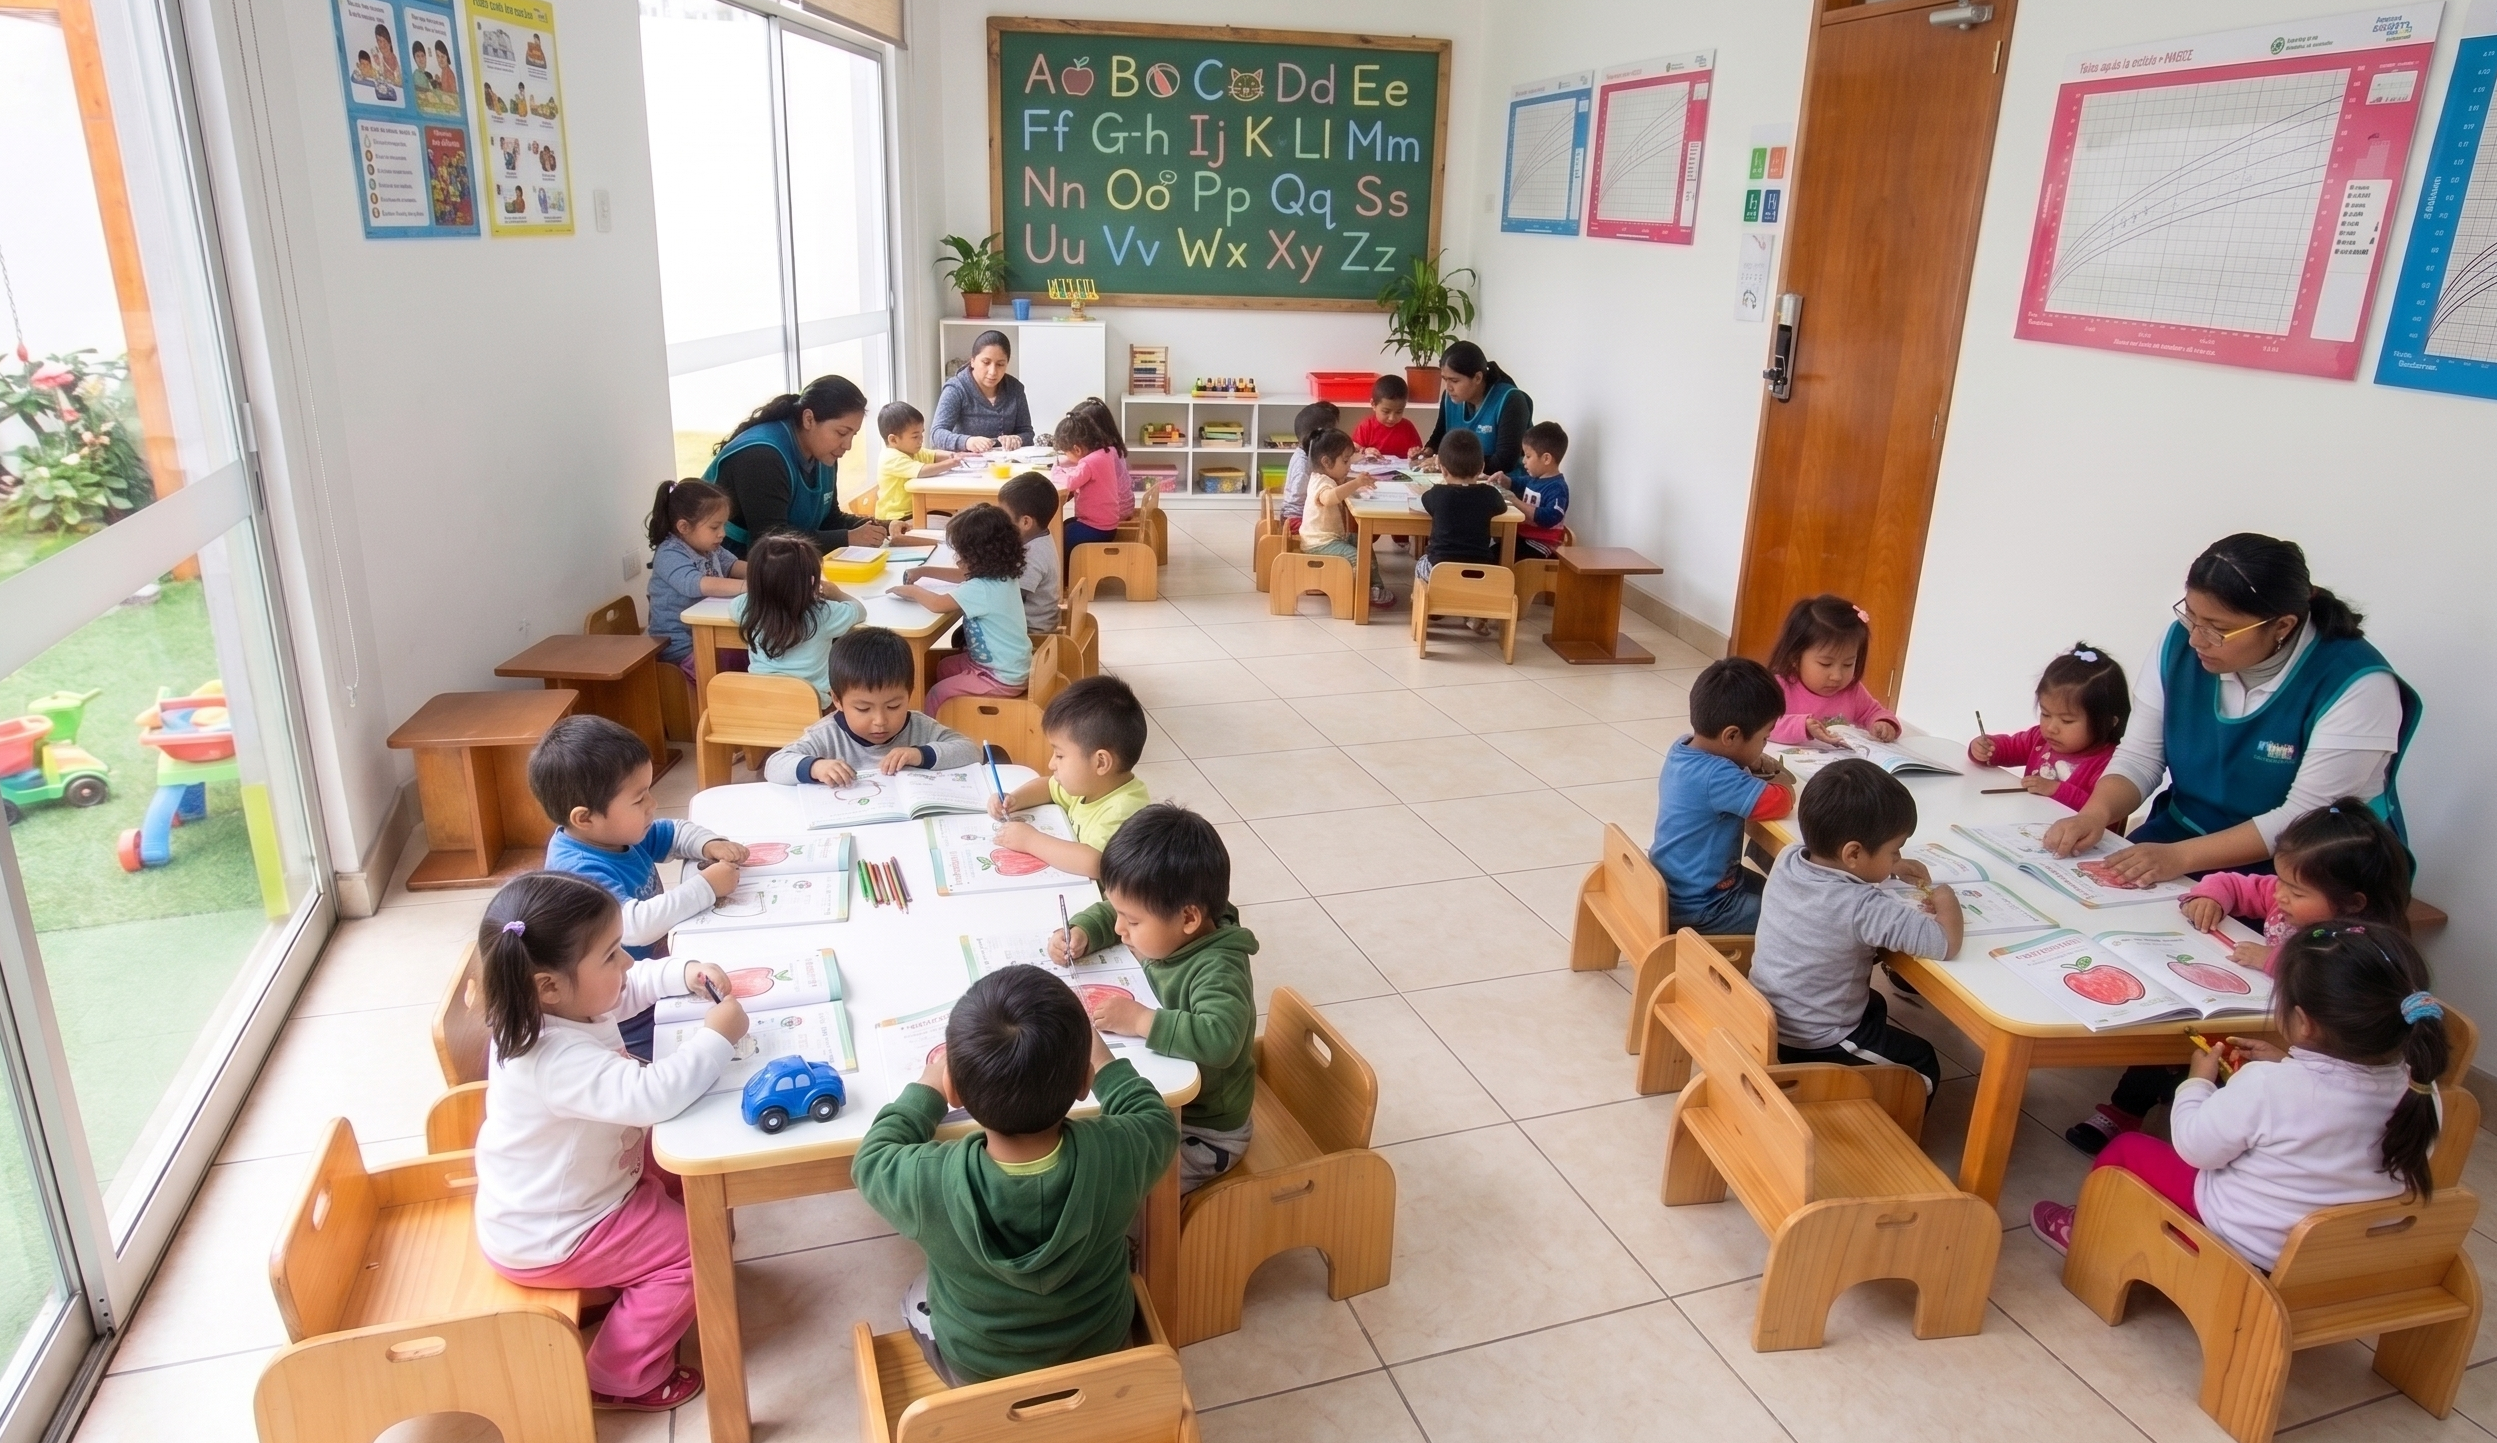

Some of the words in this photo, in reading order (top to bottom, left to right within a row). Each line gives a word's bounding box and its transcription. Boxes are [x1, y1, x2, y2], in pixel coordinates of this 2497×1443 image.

[1025, 54, 1056, 95] A
[1112, 56, 1139, 97] B
[1194, 59, 1224, 101] C
[1277, 63, 1335, 105] Dd
[1354, 64, 1409, 107] Ee
[1024, 109, 1074, 152] Ff
[1190, 115, 1225, 168] Ij
[1246, 116, 1273, 158] K
[1348, 120, 1420, 162] Mm
[1024, 166, 1086, 209] Nn
[1107, 169, 1170, 211] Oo
[1194, 171, 1251, 227] Pp
[1271, 173, 1337, 230] Qq
[1356, 176, 1409, 217] Ss
[1025, 223, 1086, 265] Uu
[1102, 225, 1160, 267] Vv
[1178, 227, 1248, 269] Wx
[1267, 229, 1323, 283] Xy
[1341, 231, 1396, 272] Zz
